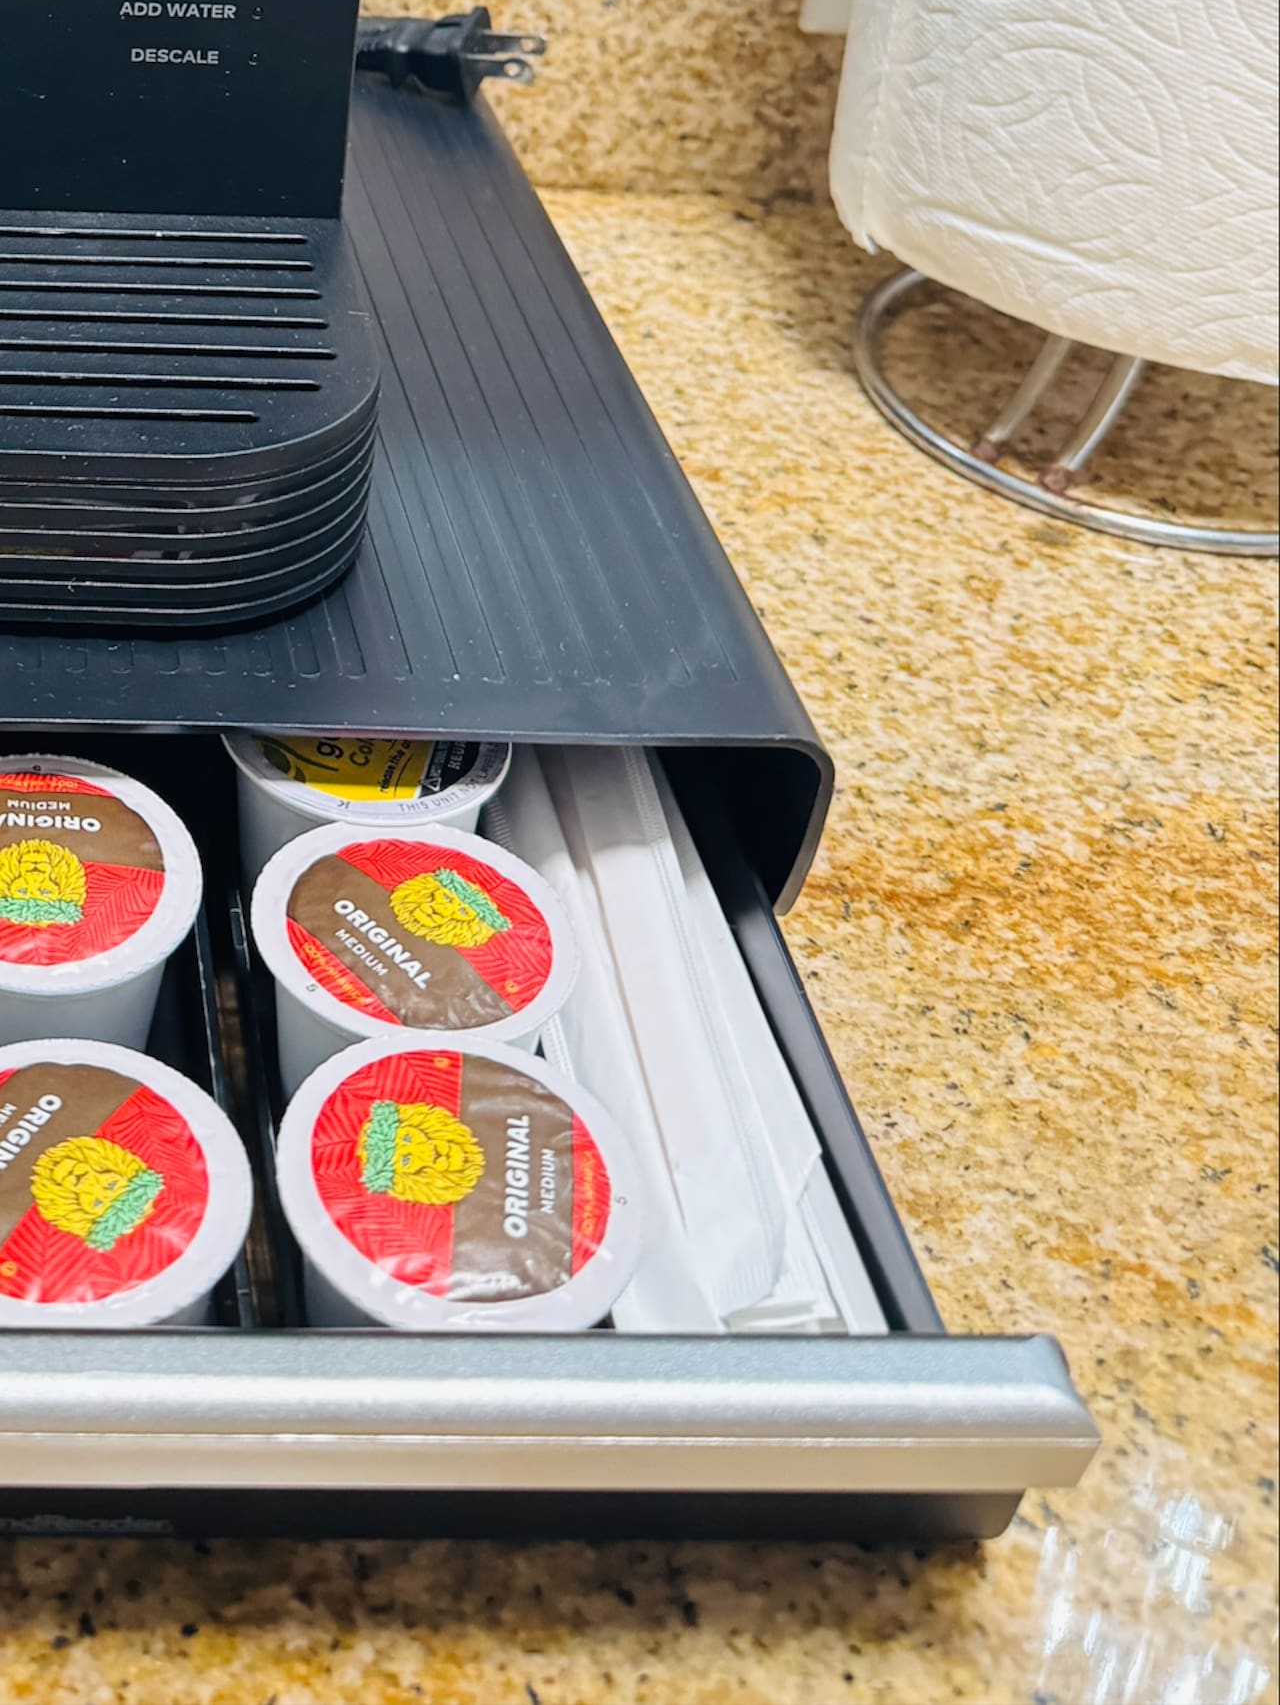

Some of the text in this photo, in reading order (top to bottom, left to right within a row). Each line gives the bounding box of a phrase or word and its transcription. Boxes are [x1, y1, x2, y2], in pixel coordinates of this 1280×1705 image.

[119, 1, 237, 19] ADD WATER
[130, 47, 220, 64] DESCALE
[6, 798, 71, 811] MEDIUM
[398, 800, 430, 813] THIS
[431, 791, 461, 807] UNIT
[333, 898, 435, 990] ORIGINAL
[335, 928, 389, 977] MEDIUM
[503, 1114, 531, 1239] ORIGINAL
